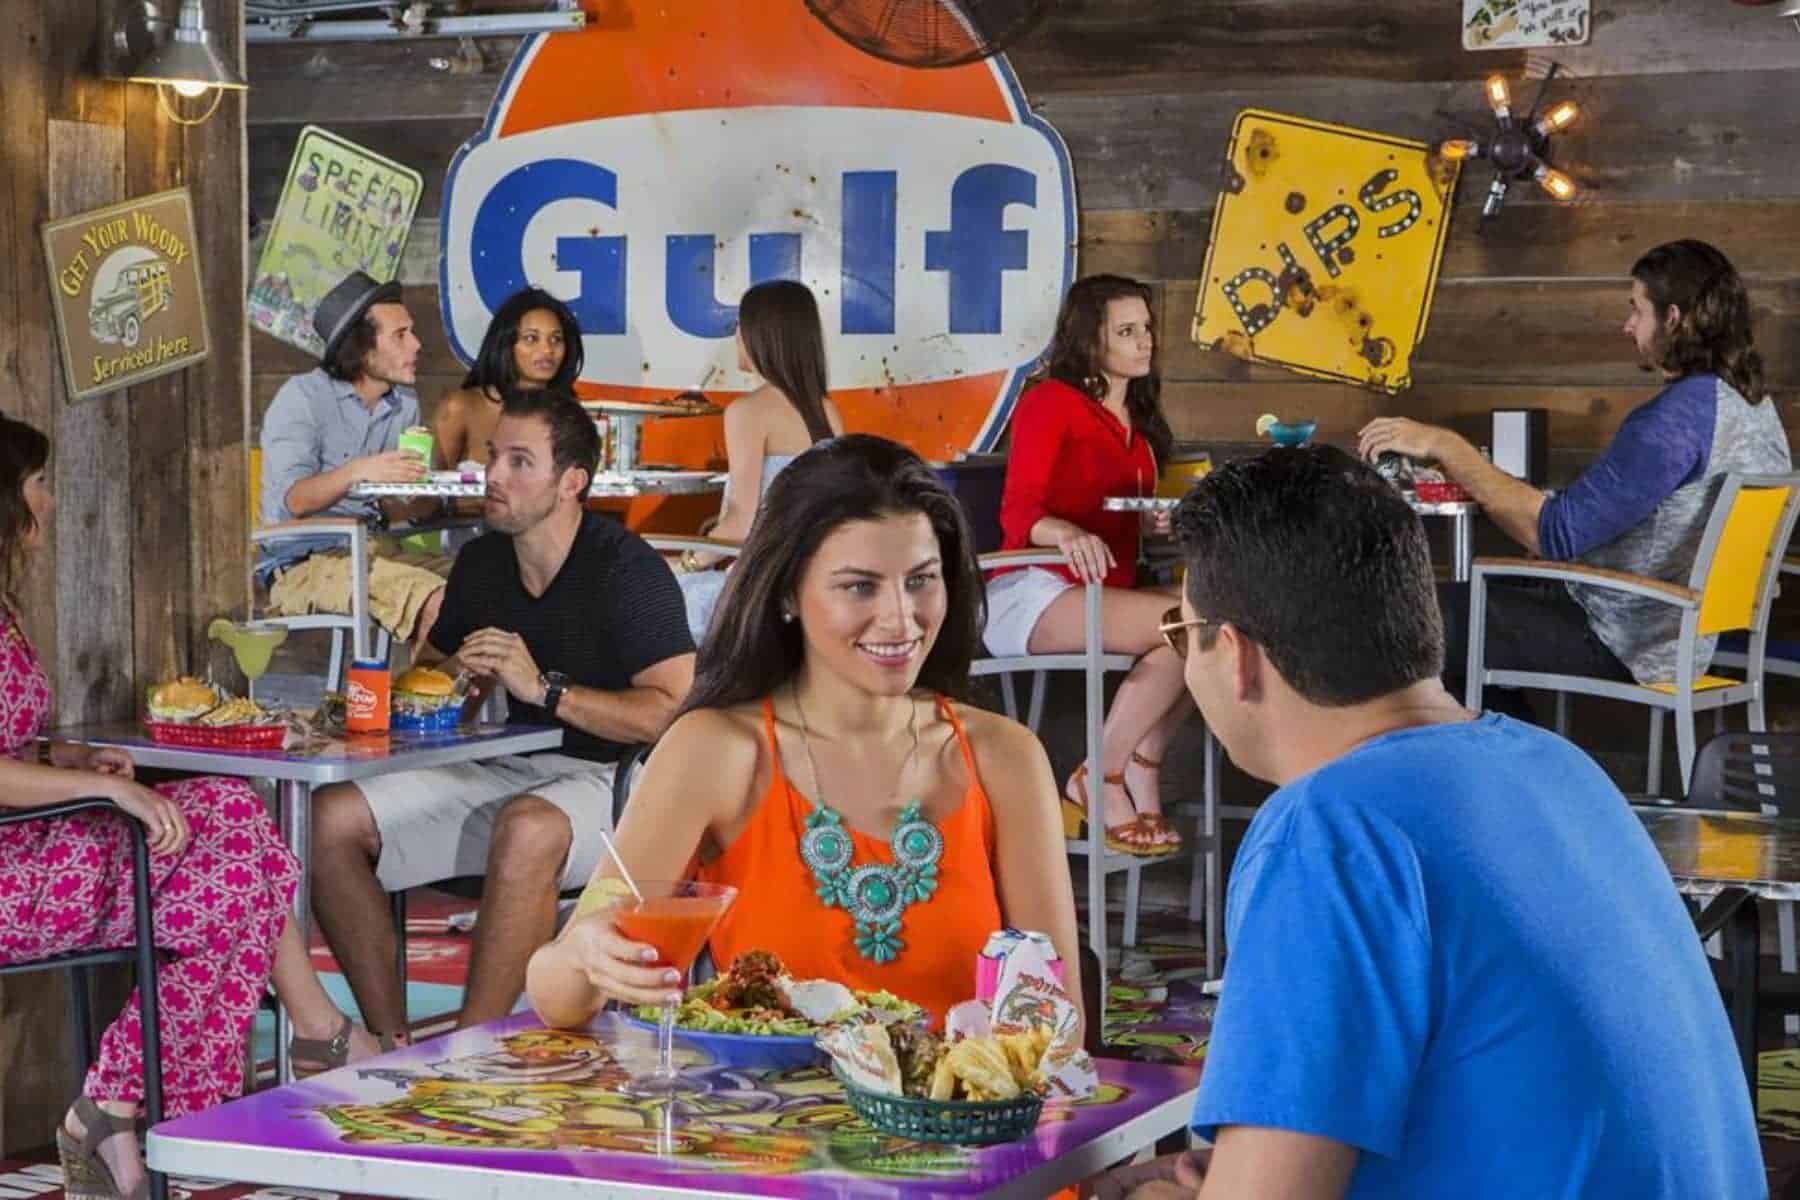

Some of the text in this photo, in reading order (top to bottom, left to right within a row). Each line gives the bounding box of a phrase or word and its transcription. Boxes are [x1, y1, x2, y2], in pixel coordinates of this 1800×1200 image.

[302, 194, 383, 248] LIMIT
[306, 152, 402, 218] SPEED
[59, 211, 190, 297] GET YOUR WOODY
[471, 158, 1037, 338] Gulf
[1222, 168, 1422, 337] DIPS
[94, 335, 190, 384] Serviced here
